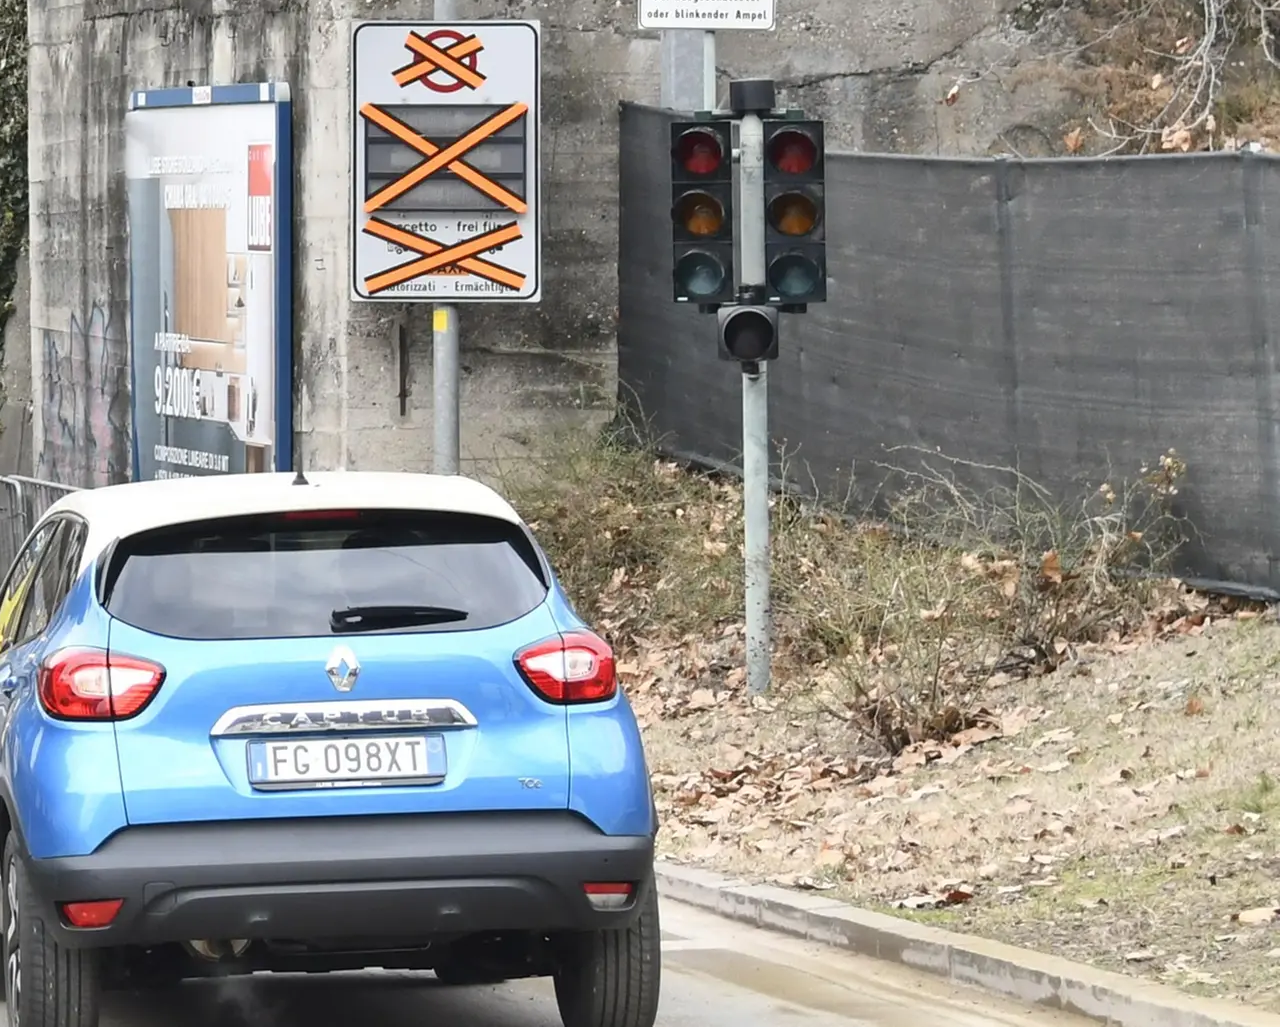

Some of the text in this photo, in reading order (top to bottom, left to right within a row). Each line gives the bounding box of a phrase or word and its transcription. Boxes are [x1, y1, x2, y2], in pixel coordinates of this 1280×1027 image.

[647, 9, 768, 22] oder blinkender Ampel
[248, 196, 272, 245] LUBE
[396, 220, 438, 233] cetto
[457, 220, 479, 233] frei
[154, 365, 202, 420] 9.200 €
[271, 743, 311, 777] FG
[324, 740, 422, 774] 098XT
